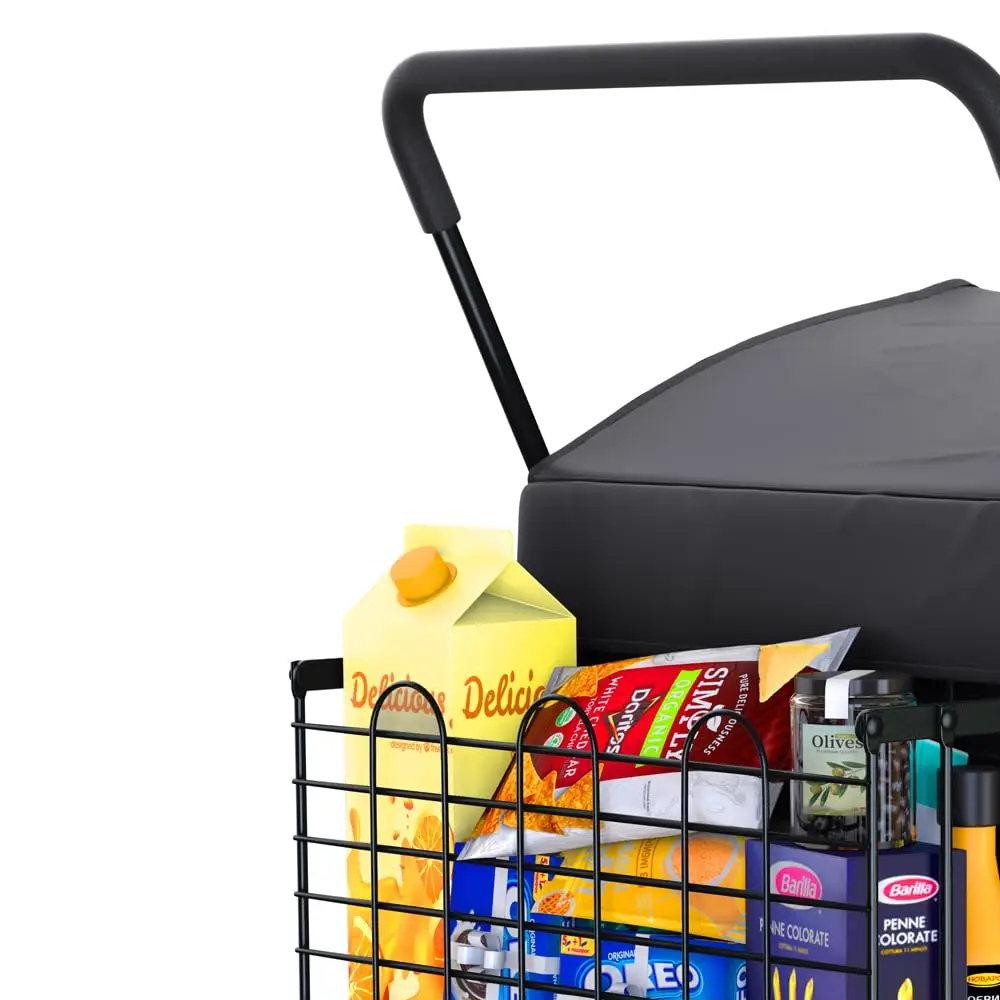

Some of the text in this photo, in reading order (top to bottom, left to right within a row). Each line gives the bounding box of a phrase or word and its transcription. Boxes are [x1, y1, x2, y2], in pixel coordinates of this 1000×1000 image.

[594, 676, 623, 712] WHITE
[606, 688, 652, 753] Doritos
[643, 679, 691, 754] ORGANIC
[703, 673, 749, 756] PURE DELIOUSNESS
[812, 734, 864, 749] Olives
[781, 873, 817, 899] Barilla
[889, 881, 933, 897] Barilla
[759, 917, 830, 948] PNNE COLORATE
[883, 915, 926, 932] PENNE
[878, 929, 938, 947] OLORATE
